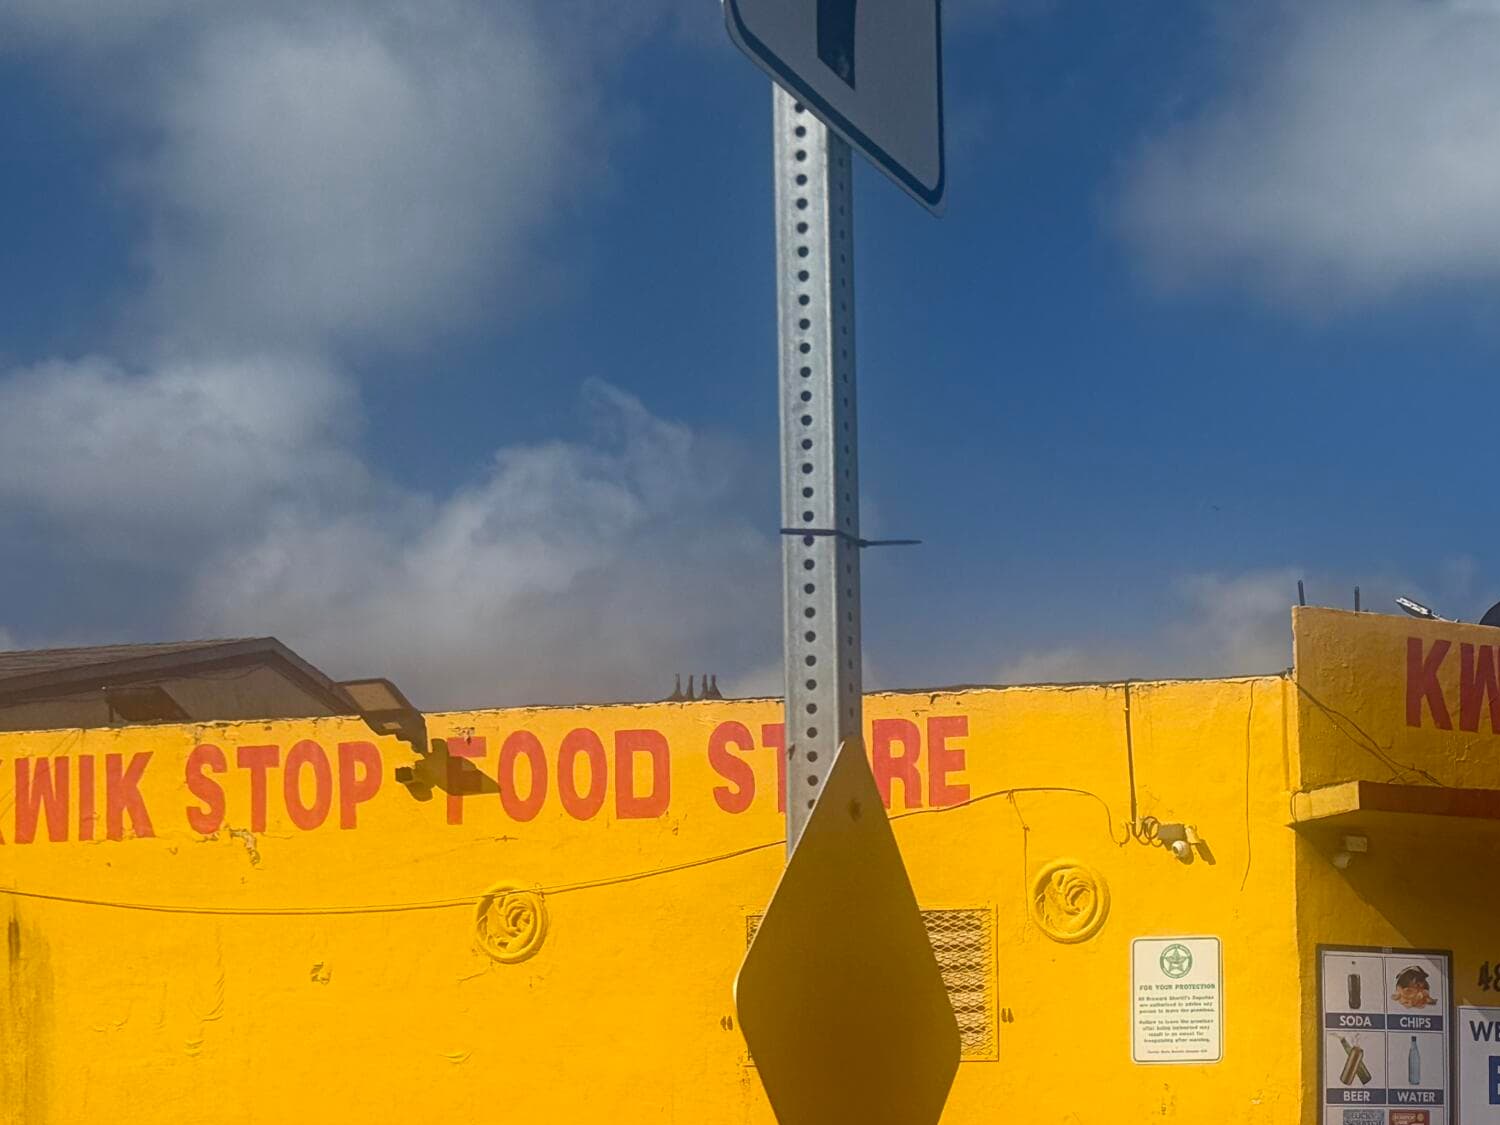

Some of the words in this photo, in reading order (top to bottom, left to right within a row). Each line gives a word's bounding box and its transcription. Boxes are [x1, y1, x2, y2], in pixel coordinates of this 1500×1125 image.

[0, 751, 156, 846] WIK
[185, 738, 383, 836] STOP
[446, 729, 671, 826] FOOD
[707, 715, 971, 815] STRE
[1339, 1015, 1372, 1027] SODA
[1399, 1016, 1432, 1029] CHIPS
[1343, 1090, 1371, 1102] BEER
[1397, 1091, 1436, 1103] WATER
